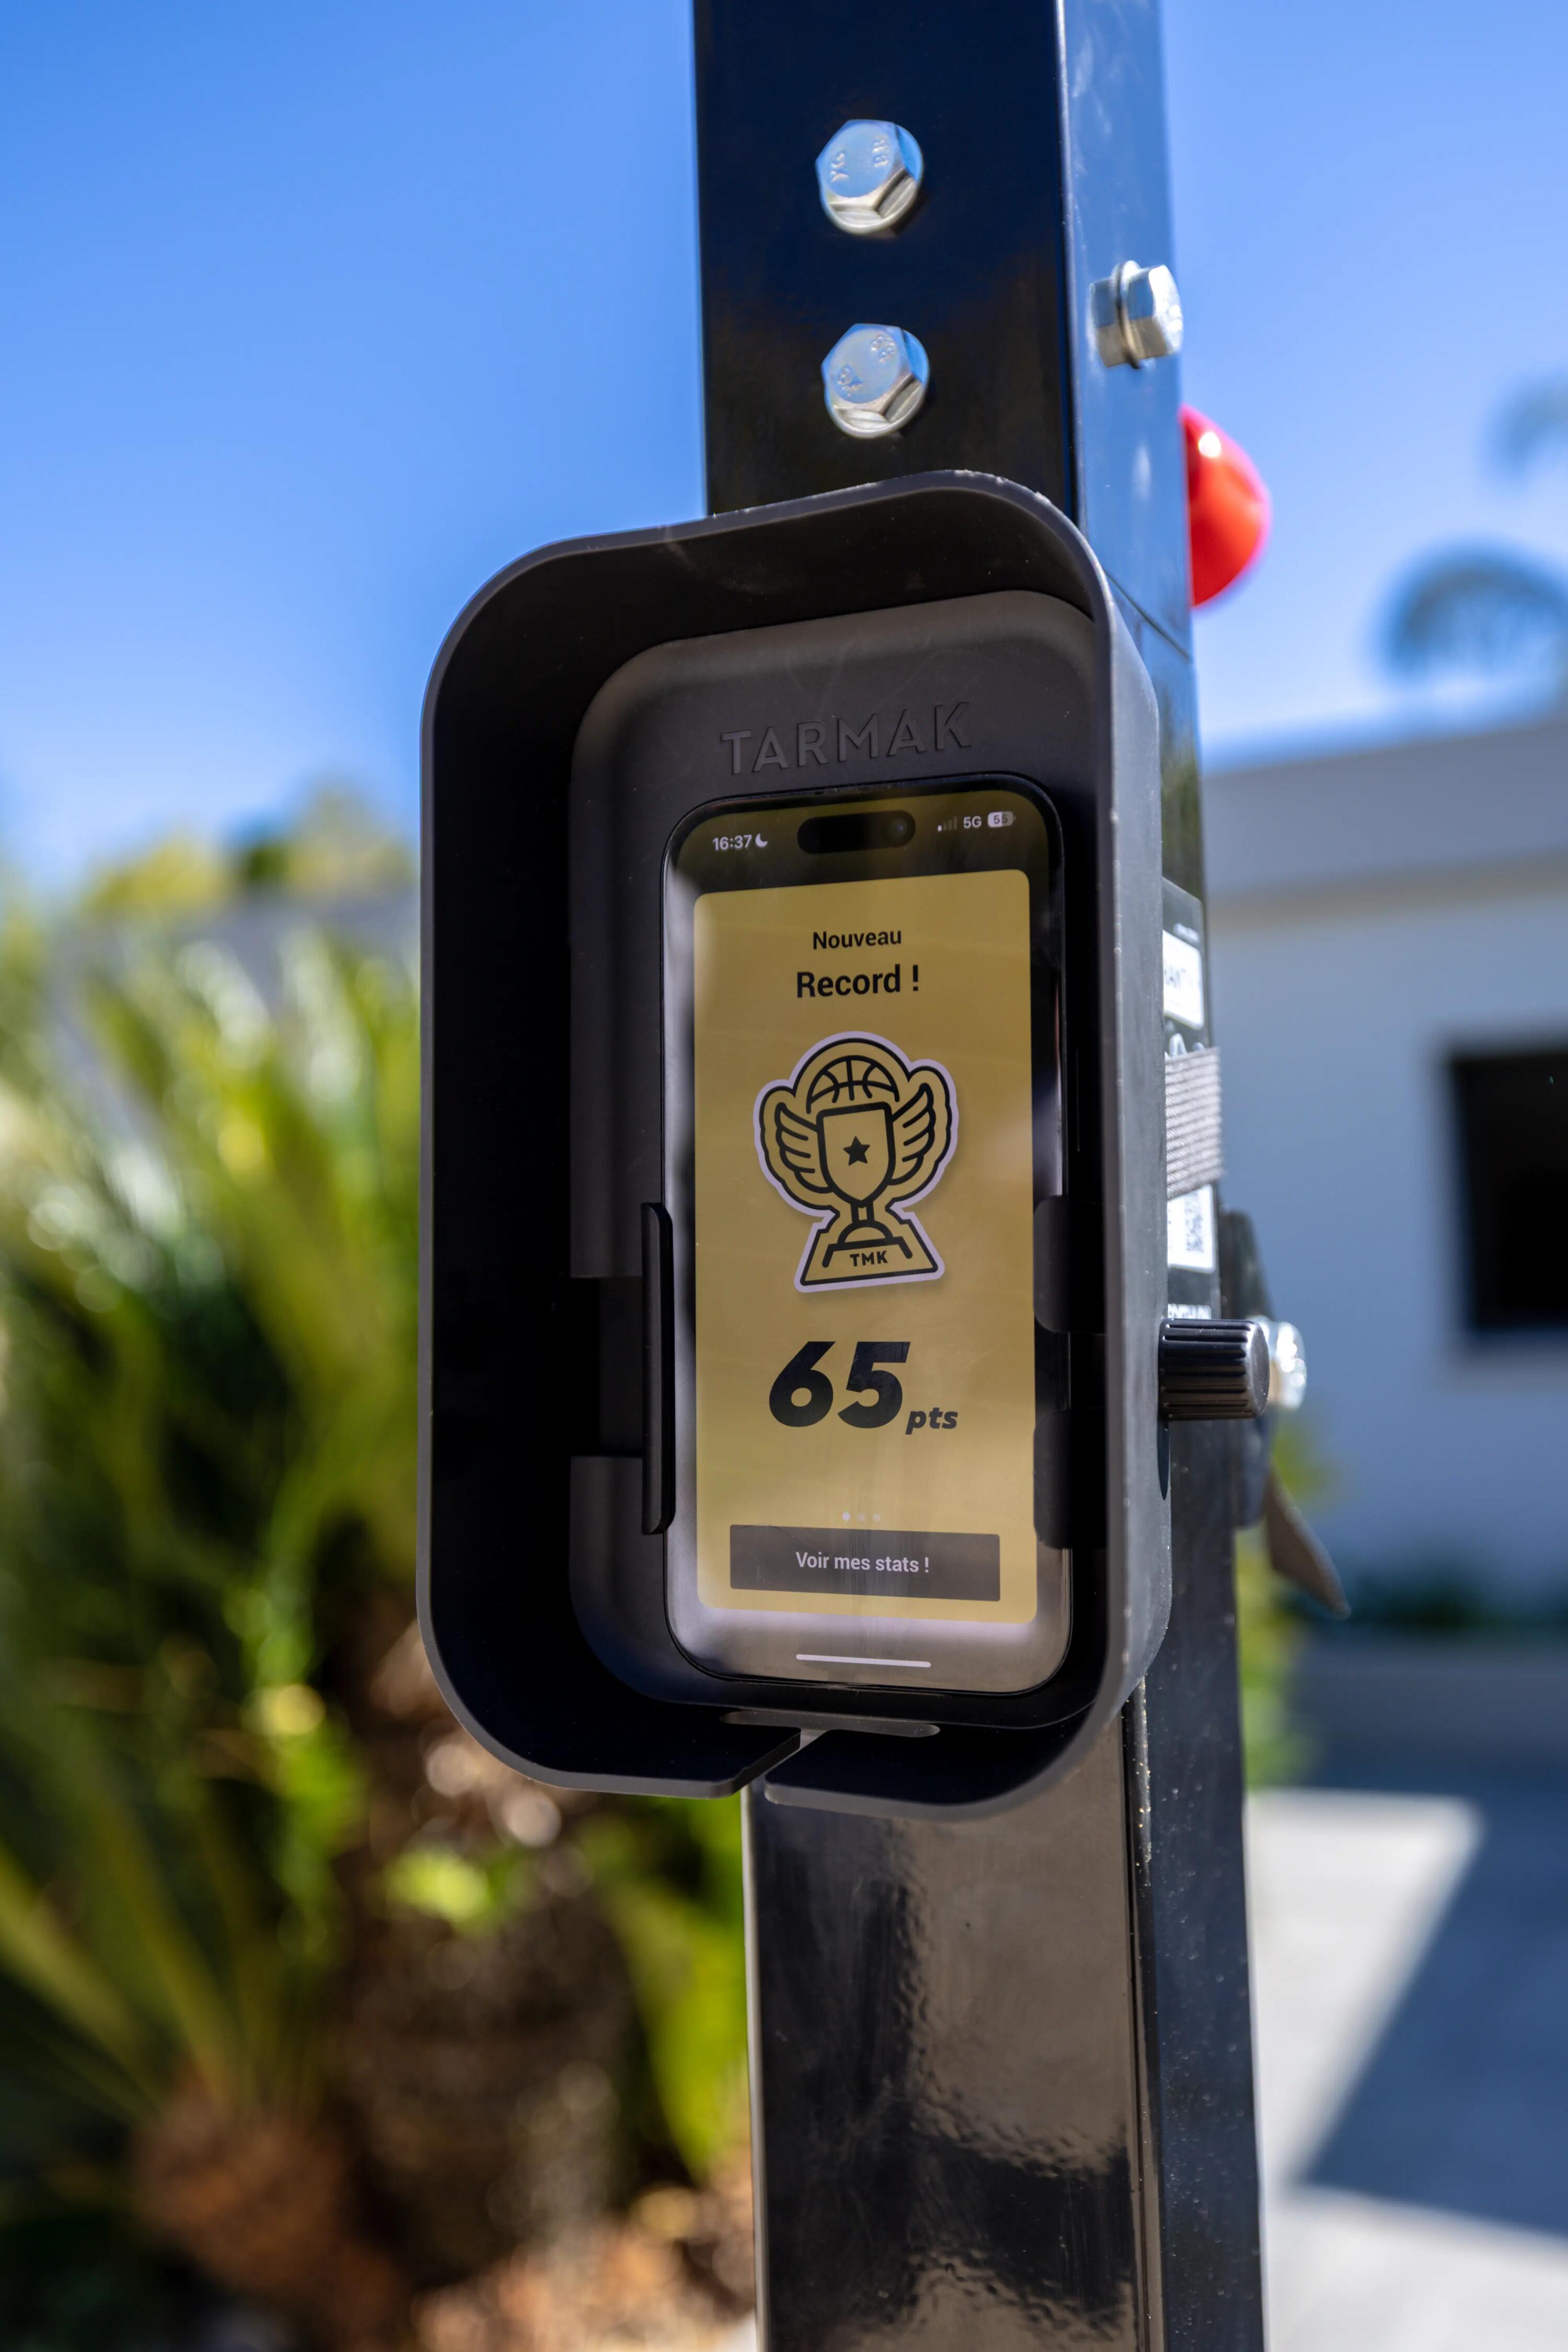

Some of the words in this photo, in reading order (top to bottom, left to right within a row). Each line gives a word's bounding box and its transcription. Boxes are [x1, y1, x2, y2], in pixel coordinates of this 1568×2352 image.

[721, 701, 972, 775] TARMAK
[963, 815, 982, 829] 5G
[712, 834, 753, 851] 16:37
[812, 930, 902, 950] Nouveau
[797, 964, 901, 998] Record
[913, 964, 919, 992] !
[849, 1250, 888, 1267] TMK
[769, 1341, 911, 1428] 65
[905, 1407, 959, 1435] pts
[795, 1551, 829, 1569] Voir
[834, 1557, 870, 1571] mes
[875, 1557, 919, 1573] stats
[925, 1557, 929, 1573] !
